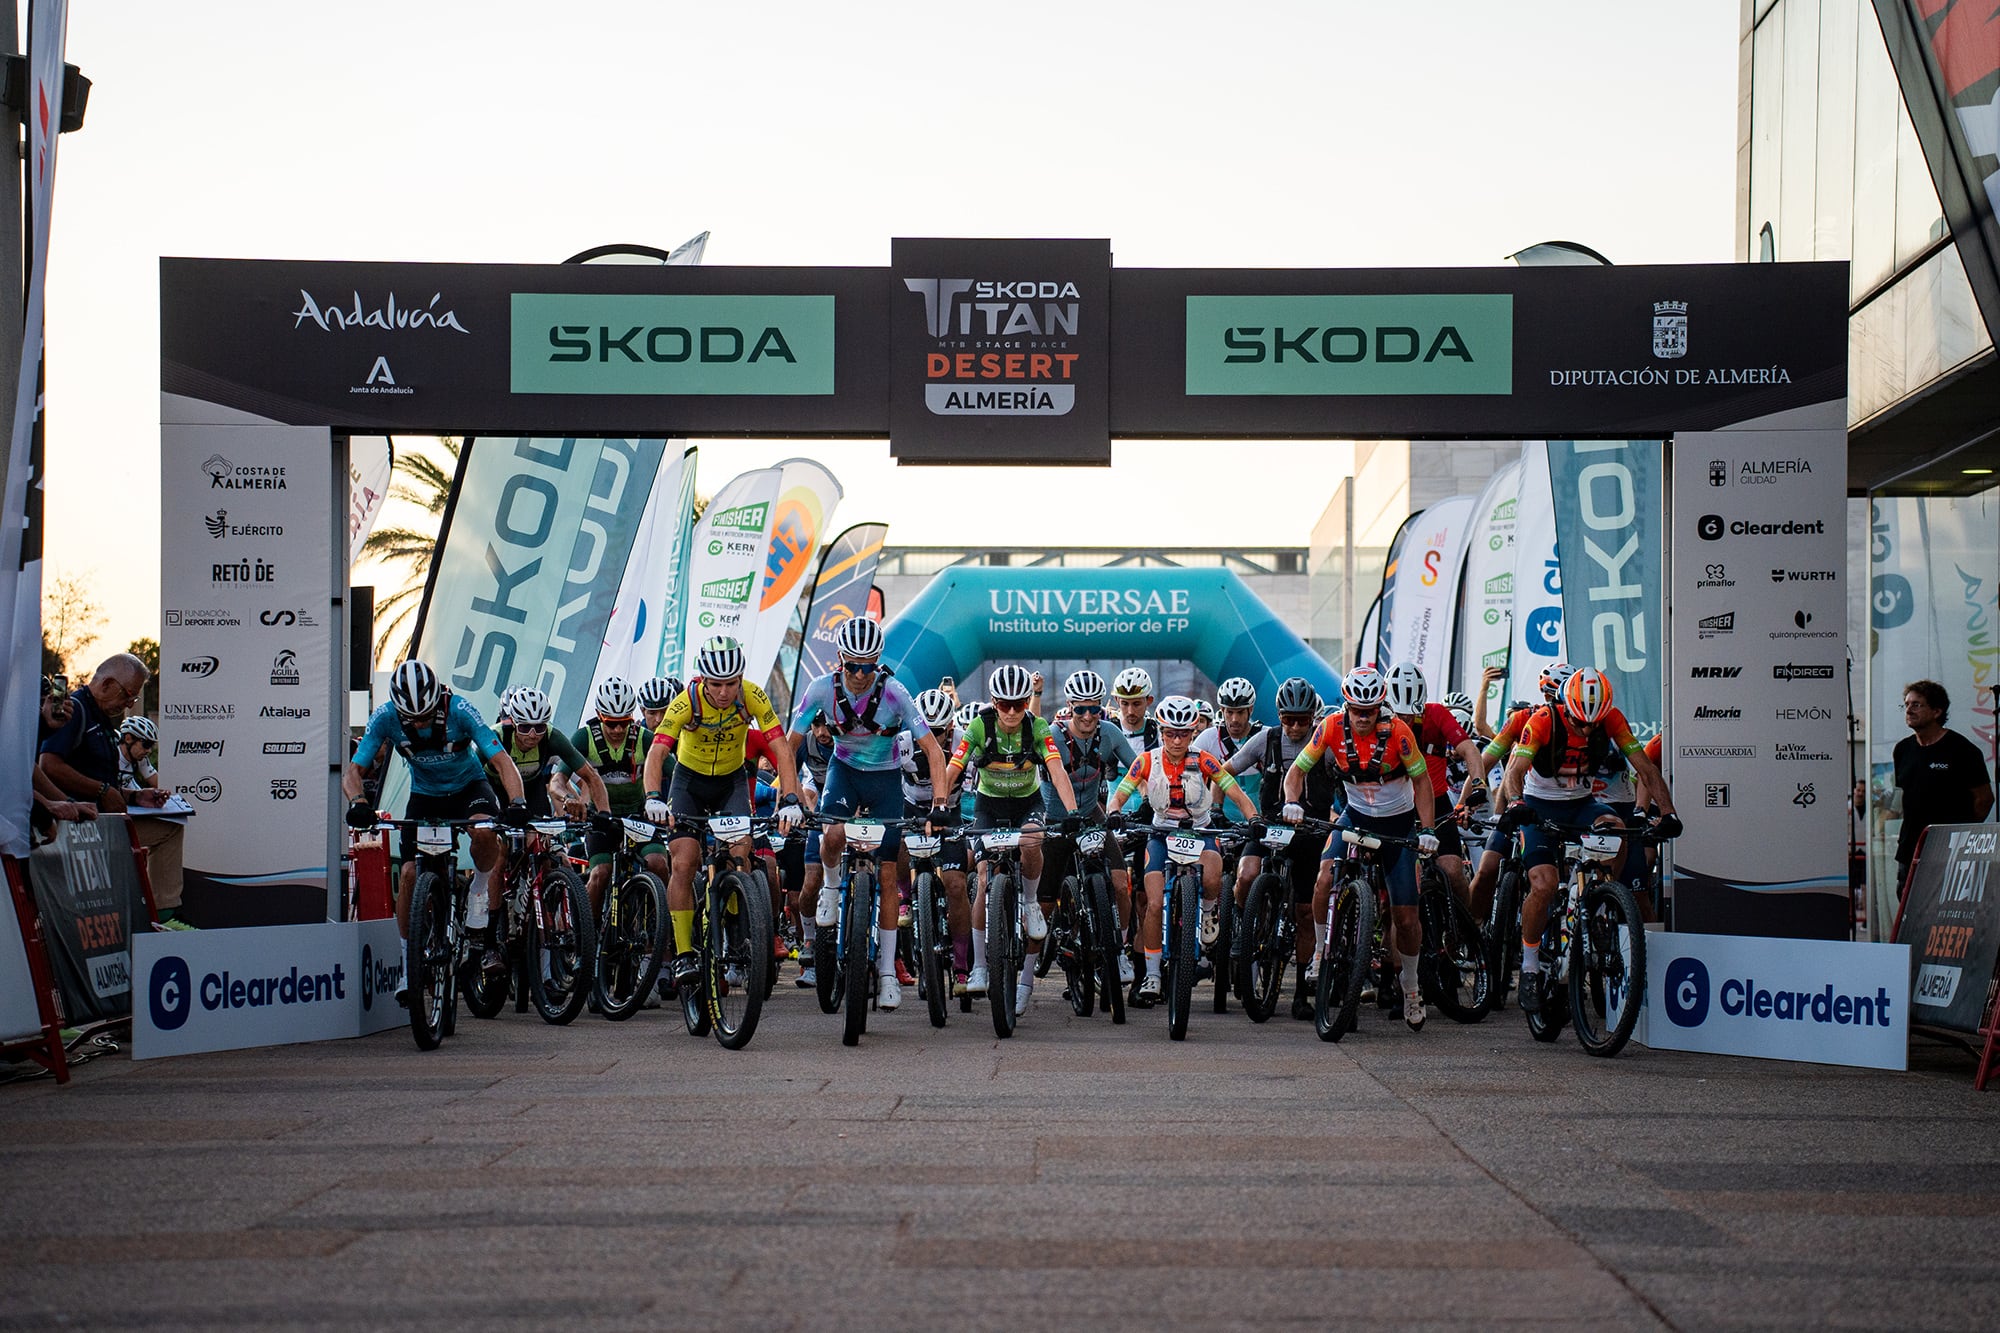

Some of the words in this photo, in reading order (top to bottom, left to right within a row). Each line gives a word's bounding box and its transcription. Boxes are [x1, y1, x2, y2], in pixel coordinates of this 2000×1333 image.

[292, 289, 470, 334] Andalucía
[938, 341, 966, 349] MTB
[976, 341, 1021, 349] STAGE
[1031, 341, 1067, 349] RACE
[927, 353, 1080, 379] DESERT
[1550, 366, 1669, 386] DIPUTACIÓN
[1676, 369, 1700, 385] DE
[1705, 364, 1792, 384] ALMERÍA
[350, 386, 370, 394] Junta
[371, 386, 379, 394] de
[380, 386, 414, 394] Andalucía
[944, 387, 1054, 409] ALMERÍA
[236, 467, 270, 476] COSTA
[273, 467, 286, 476] DE
[1741, 458, 1811, 474] ALMERÍA
[225, 476, 287, 489] ALMERÍA
[1740, 476, 1776, 484] CIUDAD
[231, 524, 283, 536] EJÉRCITO
[1730, 520, 1824, 535] Cleardent
[727, 542, 755, 552] KERN
[1697, 579, 1736, 589] primaflor
[989, 589, 1190, 615] UNIVERSAE
[185, 609, 230, 617] FUNDACIÓN
[989, 618, 1058, 633] Instituto
[1064, 618, 1136, 635] Superior
[1140, 618, 1162, 633] de
[1167, 618, 1189, 633] FP
[1769, 631, 1838, 640] quirónprevención
[1691, 667, 1743, 678] MRW
[1776, 668, 1833, 676] FINDIRECT
[165, 704, 235, 714] UNIVERSAE
[259, 706, 310, 719] Atalaya
[180, 741, 220, 750] MUNDO
[265, 744, 285, 753] SOLO
[271, 779, 297, 788] SER
[720, 818, 740, 828] 483
[432, 828, 437, 838] 1
[861, 826, 868, 836] 3
[1270, 829, 1283, 837] 29
[1175, 838, 1195, 849] 203
[1598, 836, 1605, 846] 2
[77, 912, 124, 950] DESERT
[1925, 925, 1974, 959] DESERT
[95, 957, 129, 990] ALMERÍA
[200, 964, 345, 1011] Cleardent
[1919, 970, 1953, 1000] ALMERÍA
[1720, 979, 1890, 1027] Cleardent
